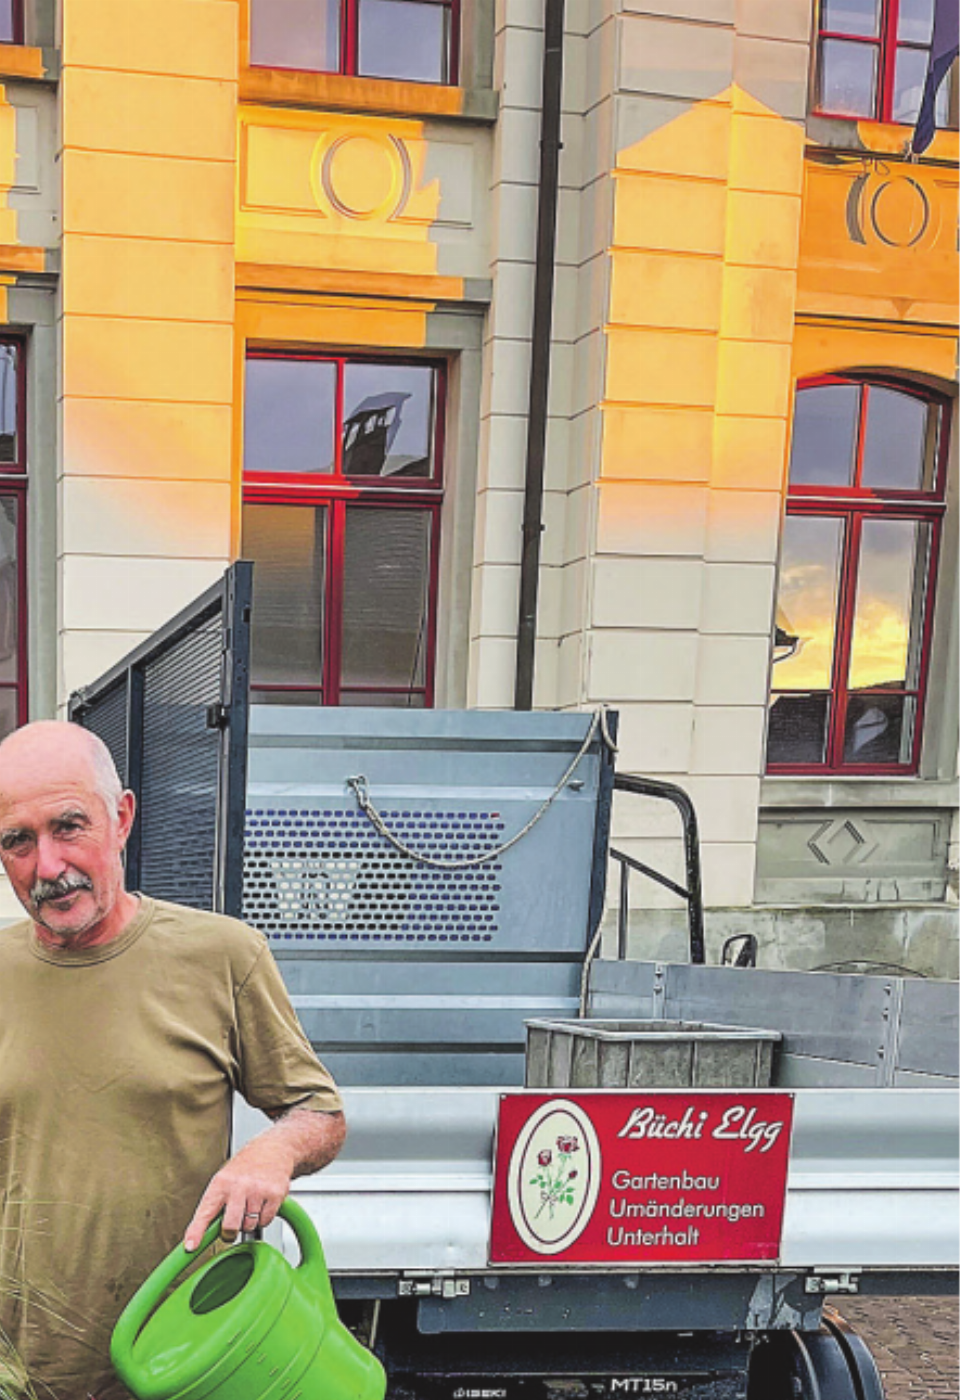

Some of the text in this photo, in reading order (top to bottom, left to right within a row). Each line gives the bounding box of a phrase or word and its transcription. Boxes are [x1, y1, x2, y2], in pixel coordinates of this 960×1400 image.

[616, 1105, 784, 1152] Büchi Elgg
[612, 1169, 720, 1190] Gartenbau
[609, 1198, 765, 1222] Umänderungen
[607, 1225, 700, 1246] Unterhalt
[611, 1378, 678, 1393] MT15n
